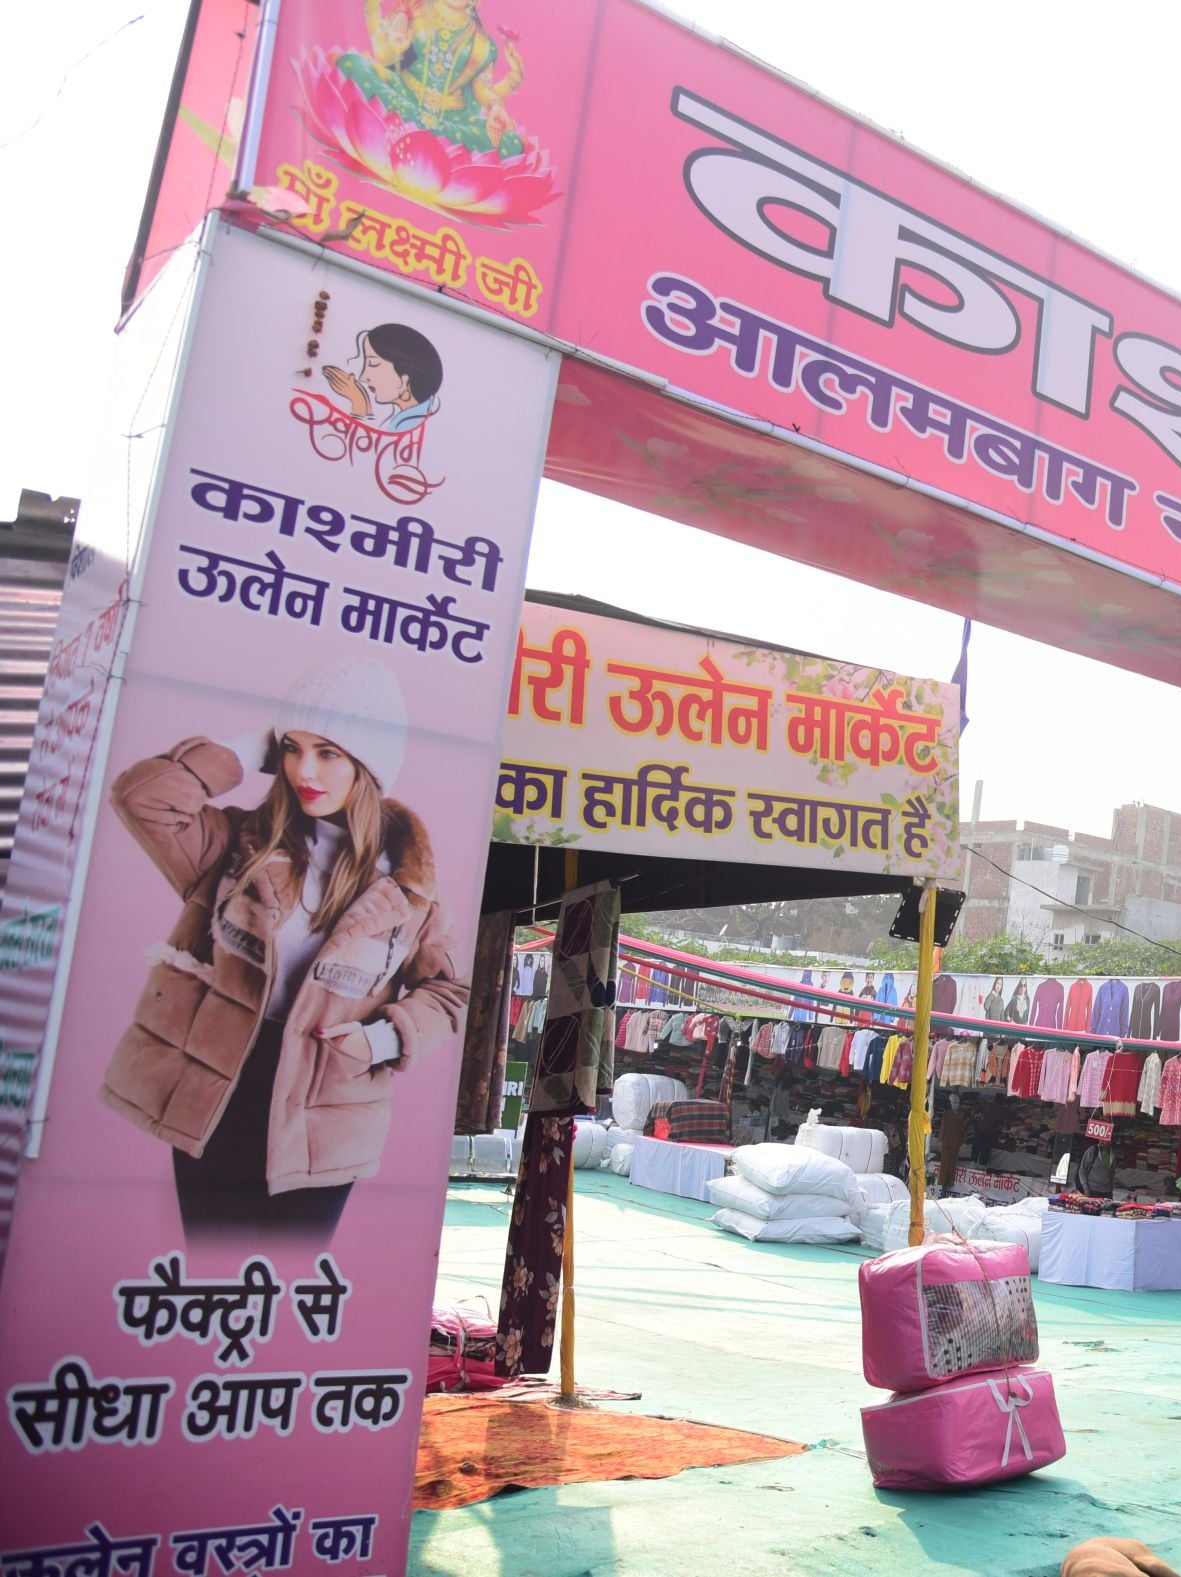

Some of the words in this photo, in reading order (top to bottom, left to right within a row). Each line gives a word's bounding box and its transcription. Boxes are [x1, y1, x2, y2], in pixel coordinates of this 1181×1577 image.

[476, 256, 543, 318] जी
[642, 273, 1138, 528] आलमबाग
[189, 467, 504, 593] काश्मीरी
[177, 543, 330, 627] ऊलेन
[340, 592, 491, 664] मार्केट
[607, 653, 774, 752] ऊलेन
[785, 688, 944, 774] मार्केट
[581, 764, 737, 834] हार्दिक
[747, 792, 892, 851] स्वागत
[902, 796, 932, 859] है
[1087, 1123, 1111, 1138] 500/-
[117, 1254, 284, 1364] फैक्ट्री
[294, 1255, 350, 1338] से
[12, 1360, 173, 1449] सीधा
[186, 1376, 303, 1437] आप
[312, 1371, 410, 1429] तक
[311, 1515, 377, 1562] का
